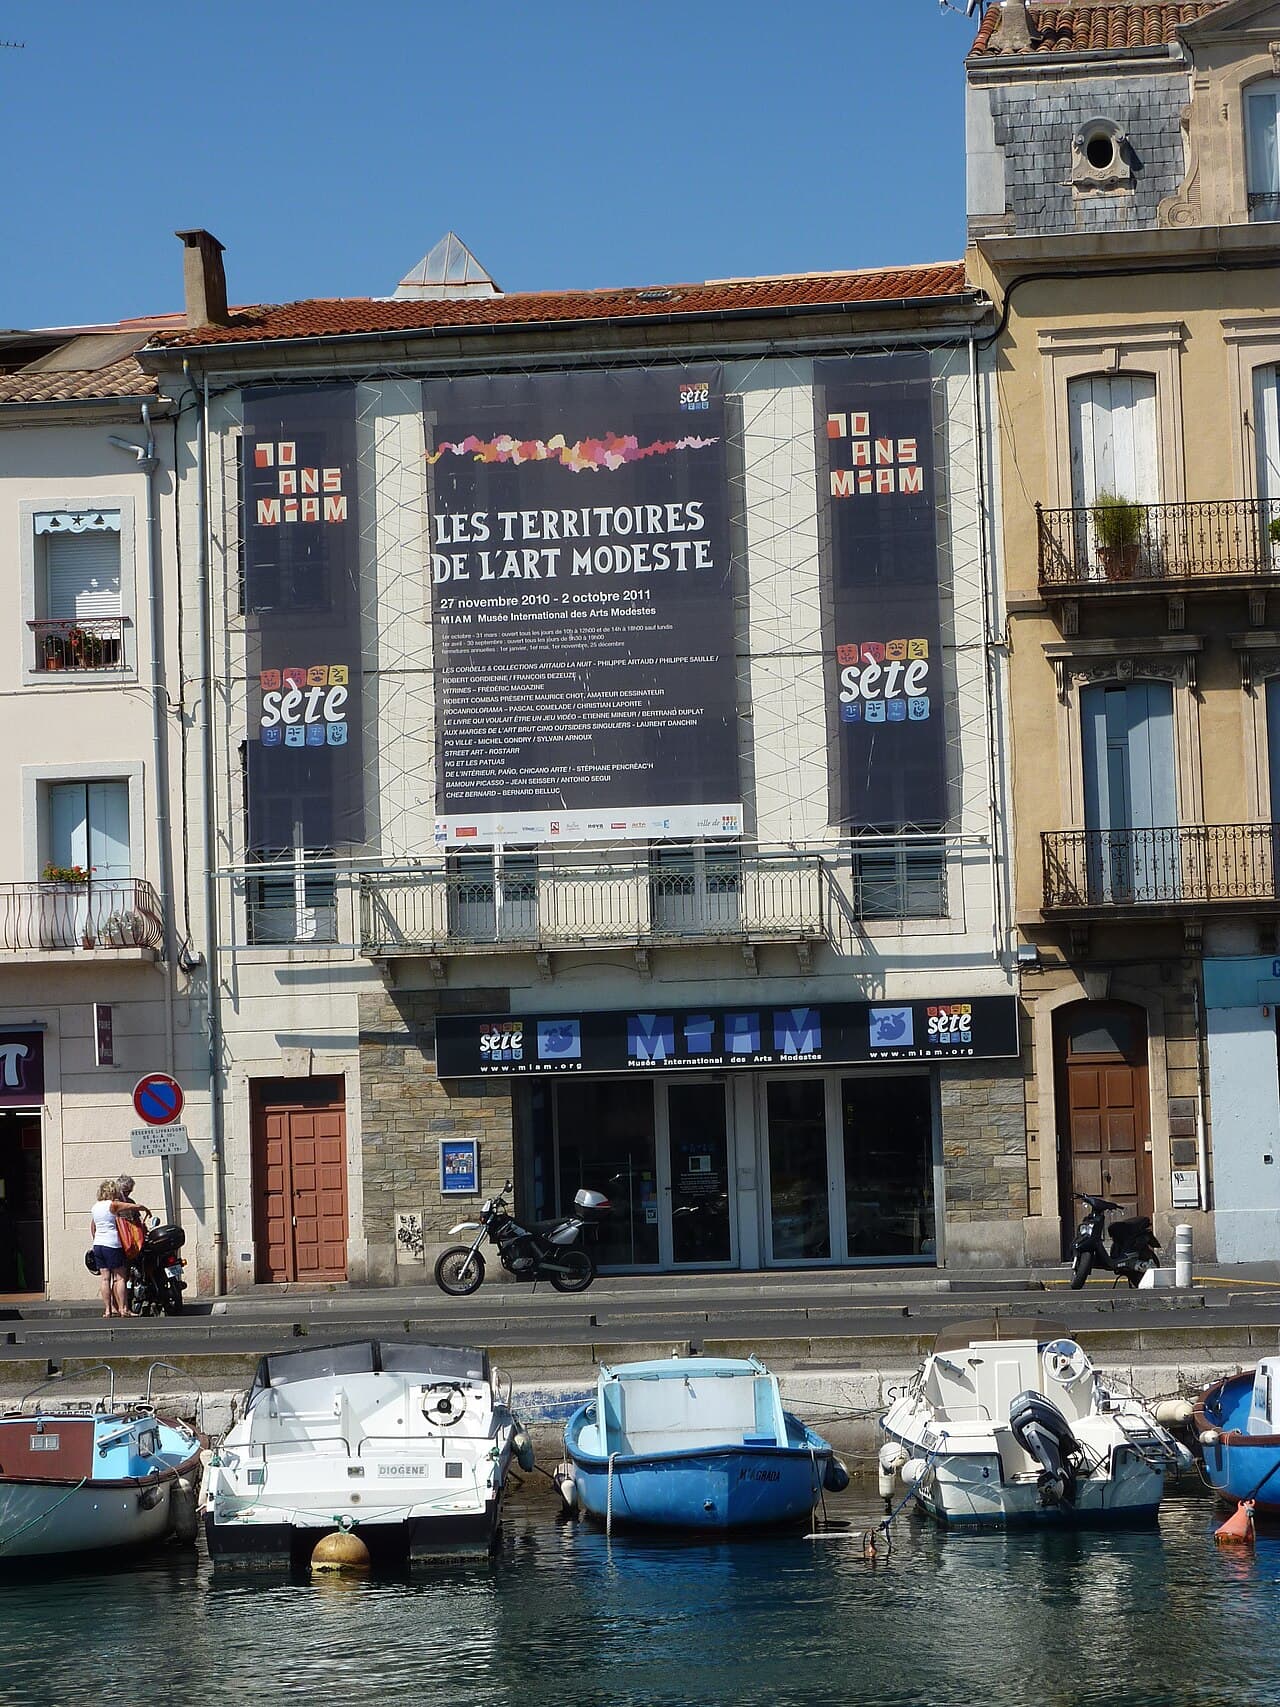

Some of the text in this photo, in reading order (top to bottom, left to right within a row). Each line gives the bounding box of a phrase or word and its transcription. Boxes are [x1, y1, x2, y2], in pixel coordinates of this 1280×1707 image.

[680, 387, 708, 404] sète
[852, 438, 917, 466] ANS
[279, 468, 342, 494] ANS
[830, 466, 923, 497] MIAM
[257, 496, 347, 525] MIAM
[433, 501, 705, 544] LES TERRITOIRES
[431, 540, 714, 584] DE L'ART MODESTE
[440, 589, 650, 609] 27 novembre 2010 2 octobre 2011
[441, 606, 656, 624] MIAM Musée International des Arts Modestes
[493, 663, 537, 671] COLLECTIONS
[659, 656, 688, 664] PHILIPPE
[840, 652, 929, 702] sète
[619, 689, 664, 697] DESSINATEUR
[261, 678, 348, 727] sète
[535, 703, 572, 711] COMELADE
[641, 709, 677, 717] BERTRAND
[554, 723, 591, 731] OUTSIDERS
[592, 721, 631, 729] SINGULIERS
[636, 720, 666, 728] LAURENT
[477, 737, 503, 745] MICHEL
[444, 749, 470, 757] STREET
[488, 747, 520, 755] ROSTARR
[475, 779, 504, 787] PICASSO
[528, 777, 555, 785] SEISSER
[560, 775, 590, 783] ANTONIO
[445, 787, 560, 799] CHEZ BERNARD BERNARD BELLUC
[927, 1010, 972, 1034] sète
[480, 1027, 522, 1051] sète
[663, 1057, 723, 1065] International
[753, 1055, 773, 1063] Arts
[780, 1053, 822, 1061] Modestes
[379, 1466, 425, 1475] DIOGENE
[982, 1467, 990, 1479] 3
